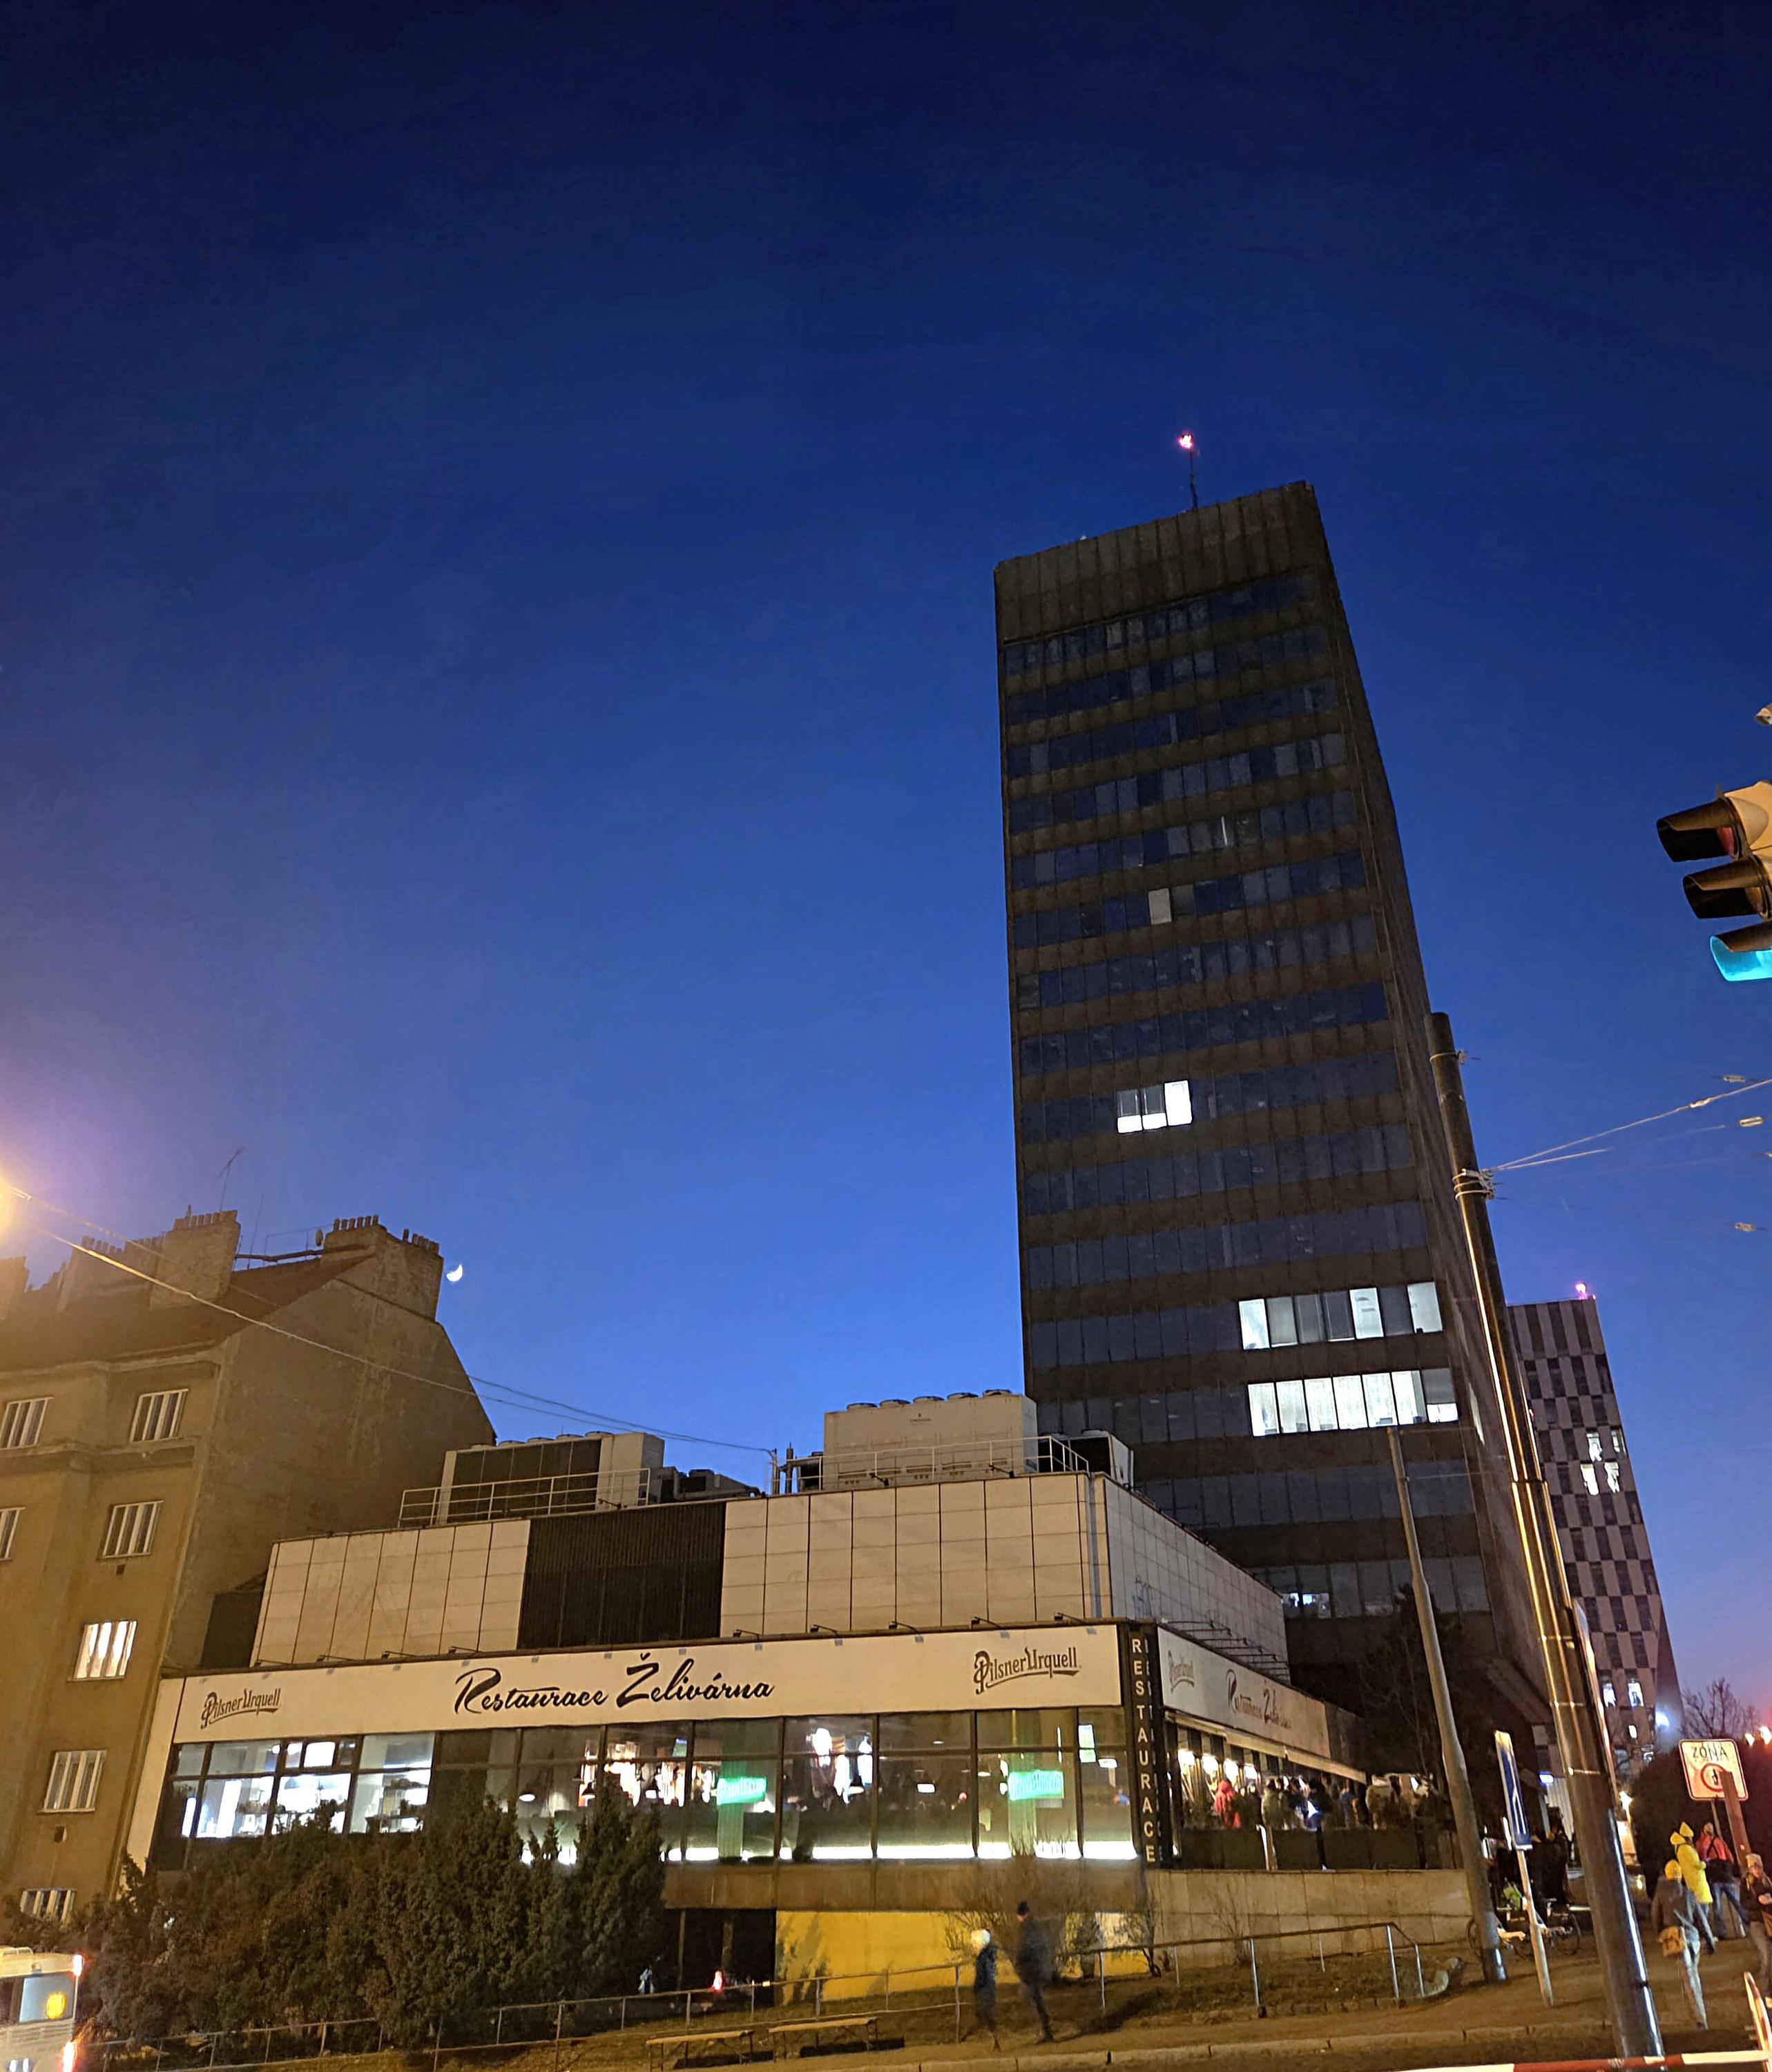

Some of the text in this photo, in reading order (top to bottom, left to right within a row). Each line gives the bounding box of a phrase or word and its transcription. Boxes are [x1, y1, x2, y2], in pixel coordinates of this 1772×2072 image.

[454, 1652, 775, 1714] Restaurace Želivárna
[974, 1647, 1077, 1694] Pilsner Urquell
[200, 1688, 280, 1729] Pilsner Urquell
[1132, 1638, 1156, 1863] RESTAURACE
[1691, 1745, 1729, 1761] ZONA
